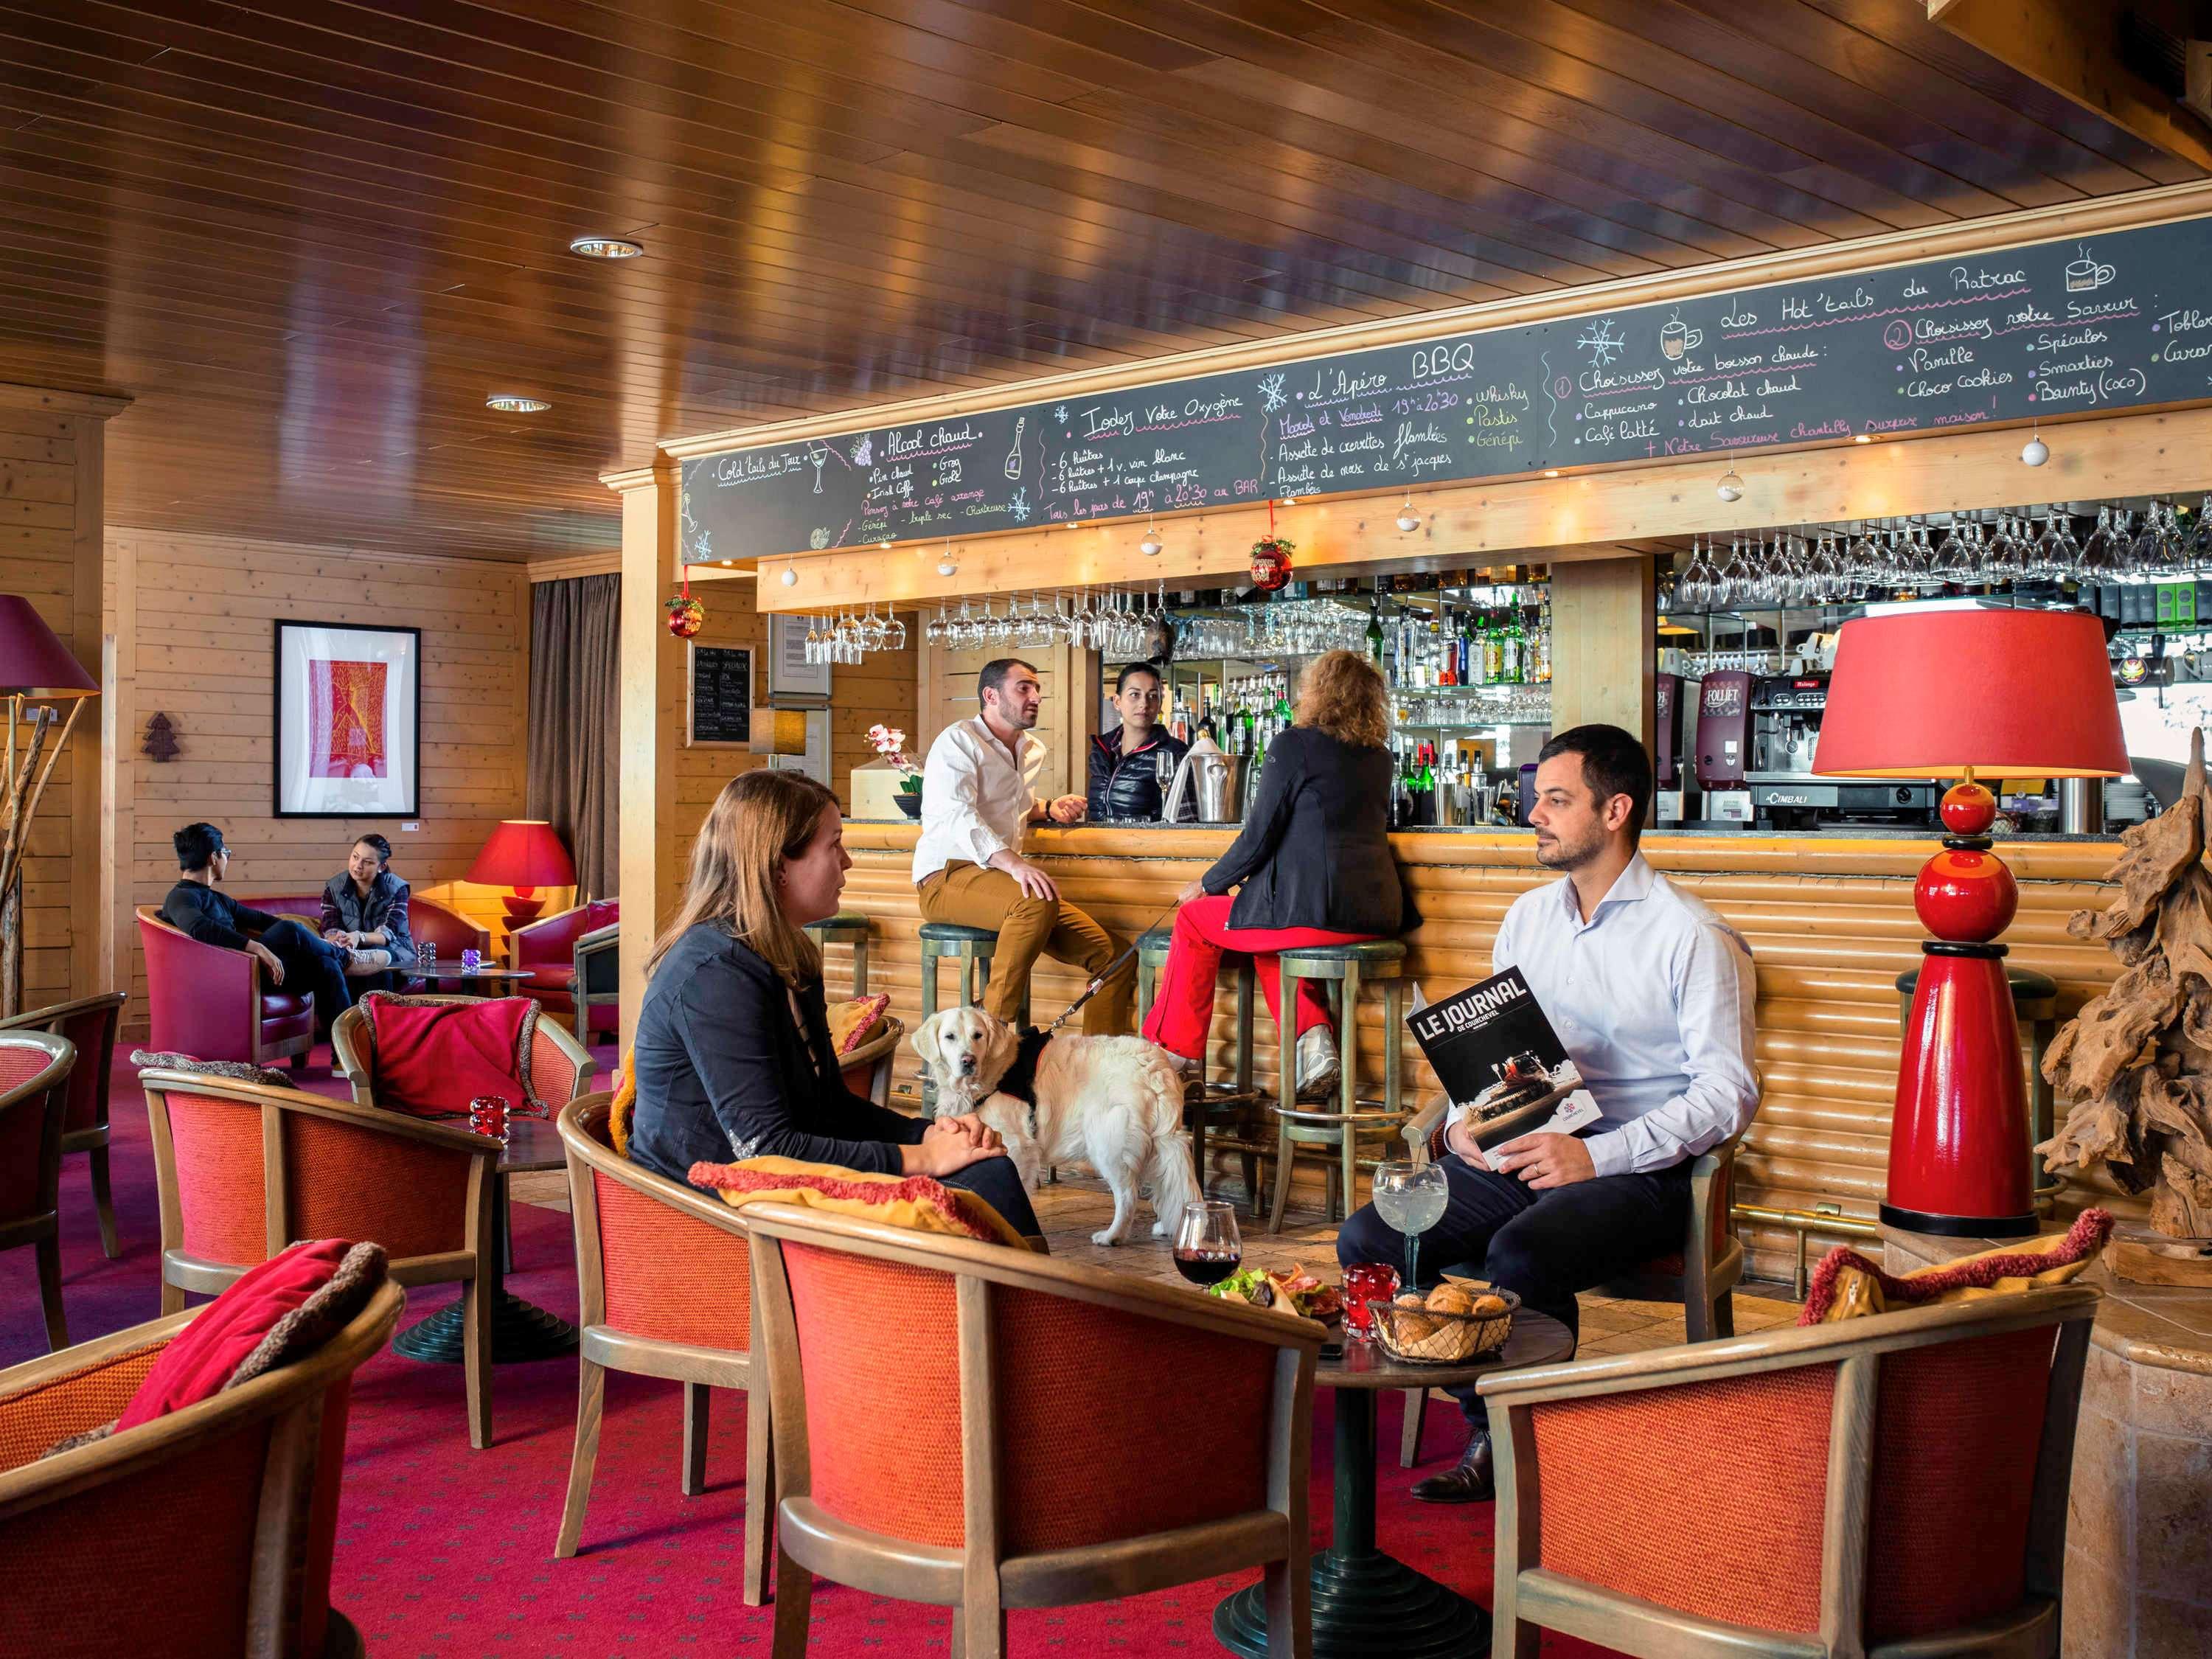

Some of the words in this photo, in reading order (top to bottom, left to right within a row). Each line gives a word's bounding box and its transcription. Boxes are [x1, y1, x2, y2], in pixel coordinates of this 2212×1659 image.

[1721, 296, 1757, 327] Les
[1781, 296, 1812, 321] Hot
[1903, 279, 1929, 298] du
[1950, 266, 2028, 291] Ratrac
[1915, 318, 1993, 340] Choisissez
[2006, 304, 2055, 326] votre
[2067, 296, 2138, 319] Saveur
[2037, 327, 2108, 350] Spéculos
[1412, 342, 1475, 380] BBQ
[1579, 369, 1665, 389] Choisissez
[1672, 355, 1705, 376] votre
[1714, 354, 1762, 371] boisson
[1908, 348, 1975, 372] Vanille
[2039, 355, 2114, 377] Smarties
[1688, 380, 1749, 404] Chocolat
[1756, 375, 1802, 396] chaud
[2036, 380, 2097, 404] Bounty
[2099, 369, 2146, 399] (coco)
[1081, 406, 1133, 438] Iodez
[1145, 406, 1178, 425] Votre
[1184, 392, 1243, 420] Oxygène
[1279, 413, 1315, 435] Mardi
[1319, 410, 1332, 425] et
[1339, 403, 1383, 422] Vendredi
[1474, 405, 1518, 428] Pastis
[1585, 400, 1657, 421] Cappuccino
[1688, 411, 1722, 429] Lait
[1729, 403, 1774, 422] chaud
[888, 429, 924, 455] Alcool
[930, 422, 977, 447] chaud
[1279, 439, 1318, 462] Assiette
[1321, 436, 1335, 456] de
[1339, 431, 1385, 453] crevettes
[1476, 428, 1523, 451] Génépi
[1585, 426, 1615, 446] Café
[1664, 436, 1703, 456] Notre
[1790, 418, 1851, 437] chantilly
[718, 459, 744, 481] Cold
[768, 459, 780, 470] du
[891, 463, 914, 479] chaud
[1059, 451, 1068, 469] 6
[1073, 449, 1103, 465] huîtres
[1059, 470, 1065, 481] 6
[1068, 466, 1096, 479] huîtres
[1107, 458, 1113, 472] 1
[1129, 458, 1147, 469] vin
[1152, 448, 1186, 465] blanc
[1278, 465, 1315, 484] Assiette
[1321, 462, 1335, 478] de
[1374, 454, 1389, 472] de
[871, 484, 894, 499] Irish
[1059, 481, 1066, 493] 6
[1068, 479, 1098, 493] huîtres
[1113, 474, 1120, 485] 1
[861, 500, 888, 518] Pensez
[892, 500, 899, 511] à
[1073, 498, 1087, 516] les
[1112, 494, 1127, 509] de
[1164, 487, 1173, 504] à
[1214, 488, 1229, 496] au
[1234, 479, 1258, 495] BAR
[1707, 689, 1739, 702] FOLLIET
[1416, 1014, 1445, 1041] LE
[1441, 978, 1527, 1033] JOURNAL
[1465, 1009, 1500, 1029] COURCHEVEL
